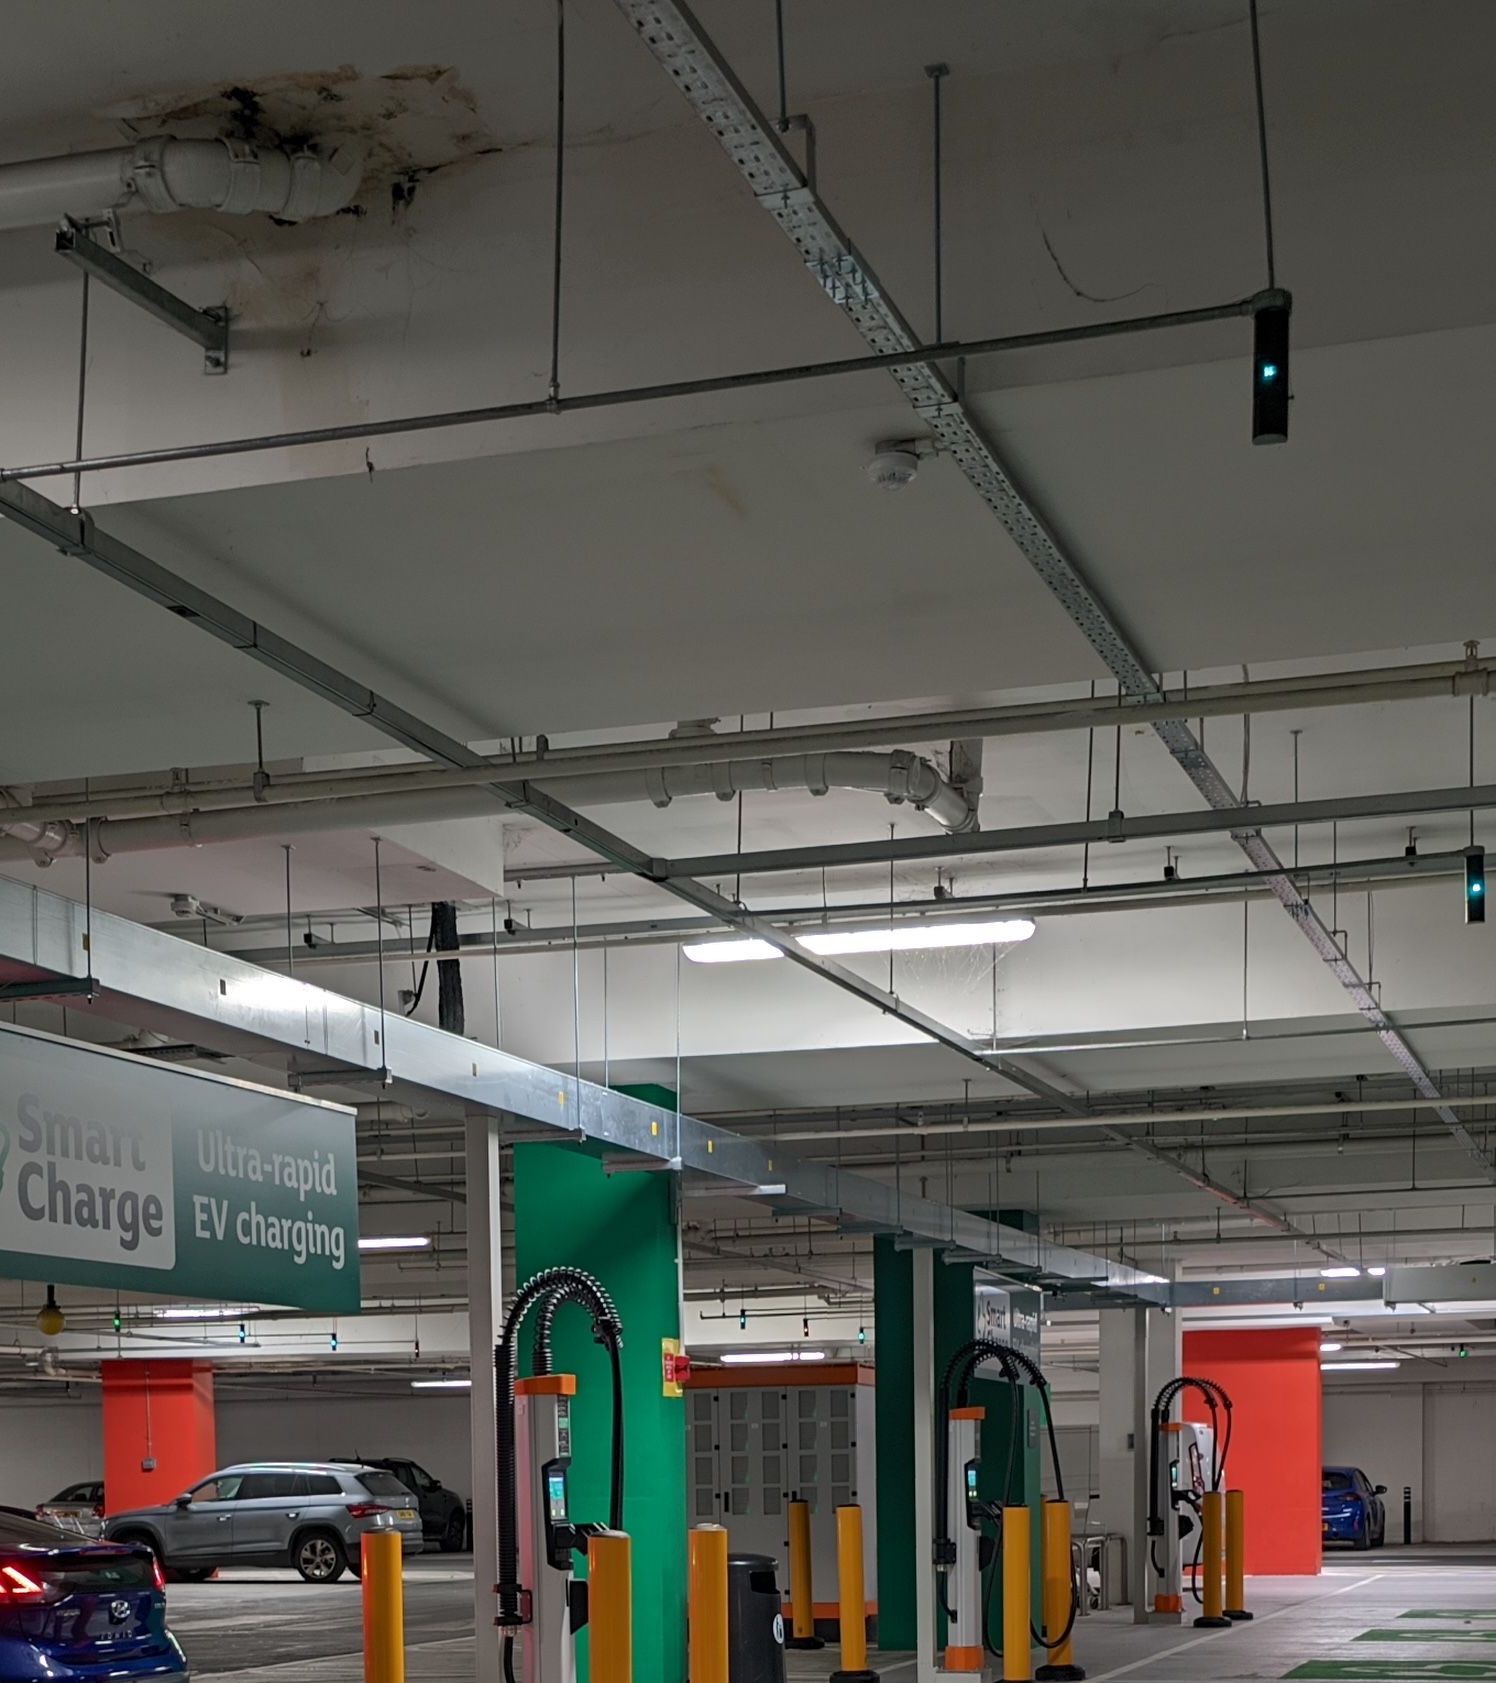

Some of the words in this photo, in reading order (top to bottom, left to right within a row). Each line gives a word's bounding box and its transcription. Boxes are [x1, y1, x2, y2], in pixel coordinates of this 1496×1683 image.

[17, 1093, 147, 1172] Smart
[197, 1129, 338, 1202] Ultra-rapid
[18, 1160, 164, 1251] Charge
[193, 1194, 229, 1241] EV
[235, 1200, 346, 1270] charging
[986, 1300, 1007, 1330] Smart
